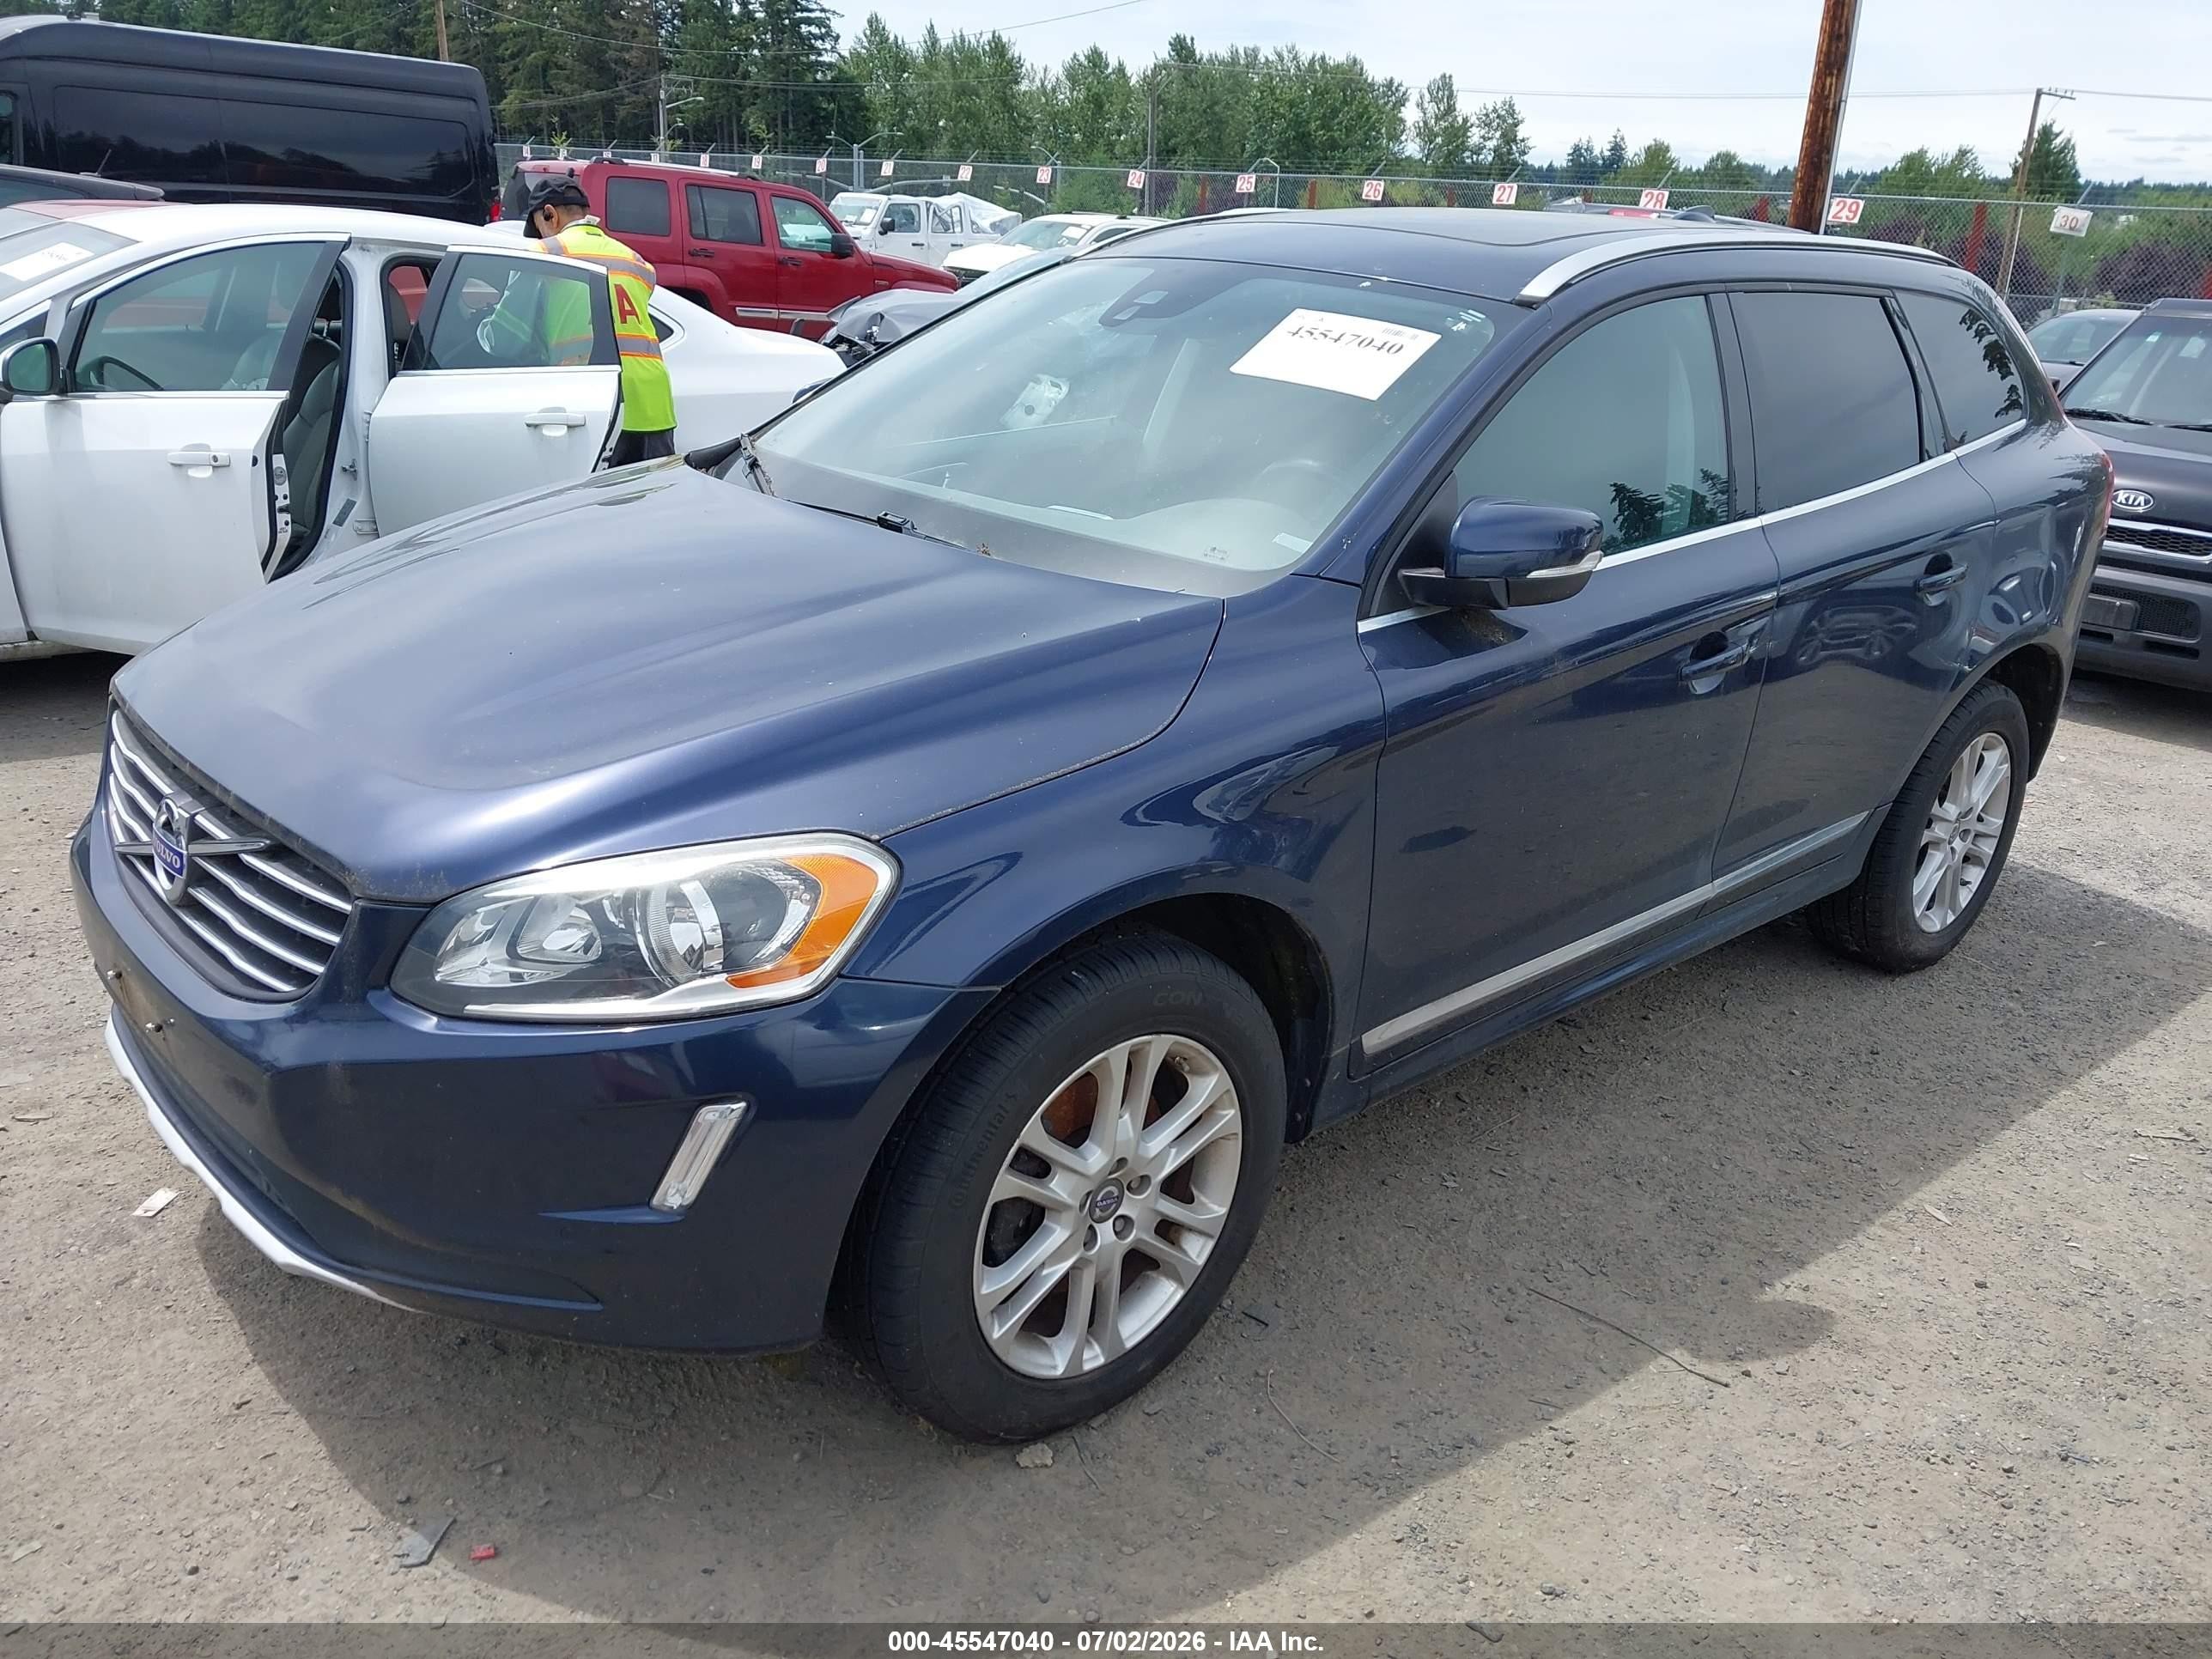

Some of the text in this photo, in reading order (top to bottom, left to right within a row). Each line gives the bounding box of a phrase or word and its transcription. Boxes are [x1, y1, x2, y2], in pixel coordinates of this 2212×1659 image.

[817, 159, 825, 171] 20
[883, 162, 892, 174] 21
[959, 167, 970, 179] 22
[1038, 167, 1051, 182] 23
[1129, 172, 1143, 187] 24
[1237, 175, 1254, 191] 25
[1364, 181, 1381, 198] 26
[1496, 185, 1514, 203] 27
[1644, 191, 1665, 209] 28
[1832, 199, 1861, 222] 29
[2060, 215, 2079, 231] 30
[614, 283, 641, 325] A
[1287, 325, 1405, 355] 45547040
[2117, 491, 2146, 507] KIA
